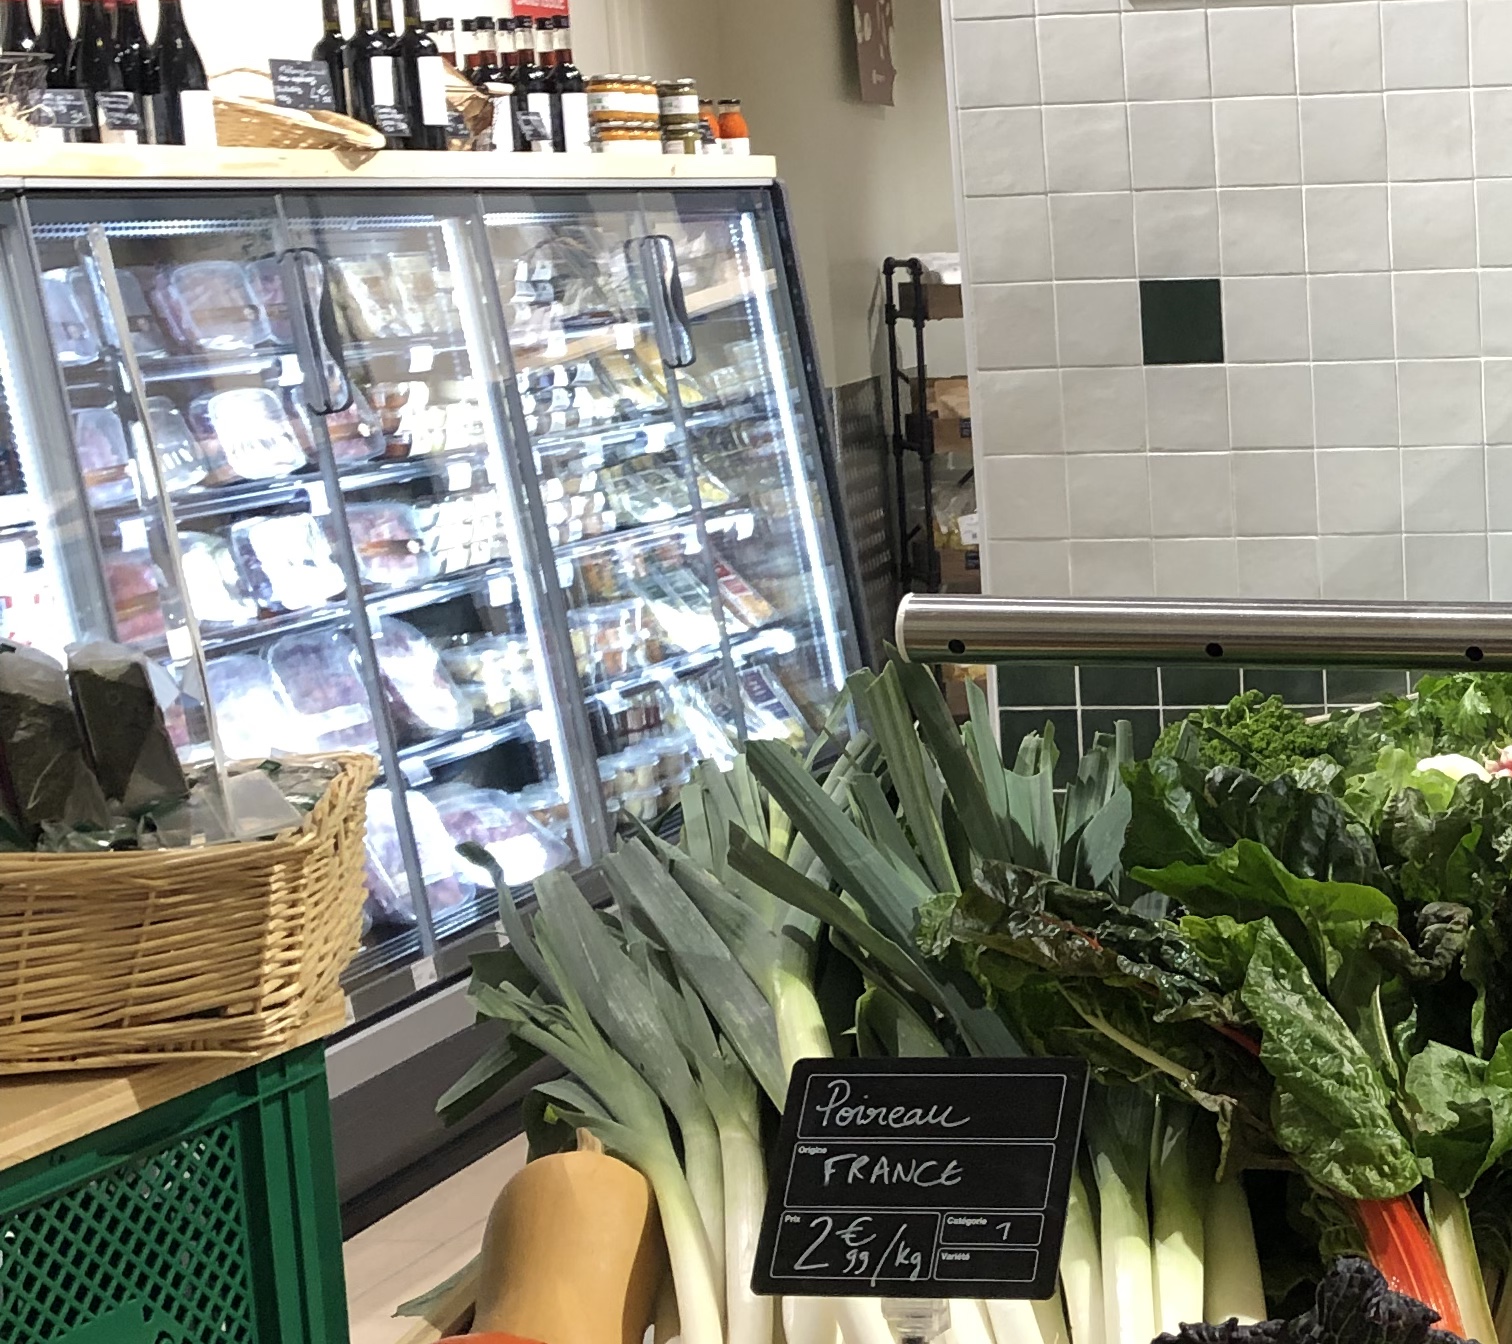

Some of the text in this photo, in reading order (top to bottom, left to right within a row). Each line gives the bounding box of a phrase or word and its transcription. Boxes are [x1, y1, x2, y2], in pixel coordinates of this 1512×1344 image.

[816, 1079, 971, 1129] Poireau
[798, 1146, 827, 1155] Origine
[823, 1154, 965, 1187] FRANCE
[784, 1214, 801, 1223] Prix
[947, 1216, 1012, 1241] Catégorie 1
